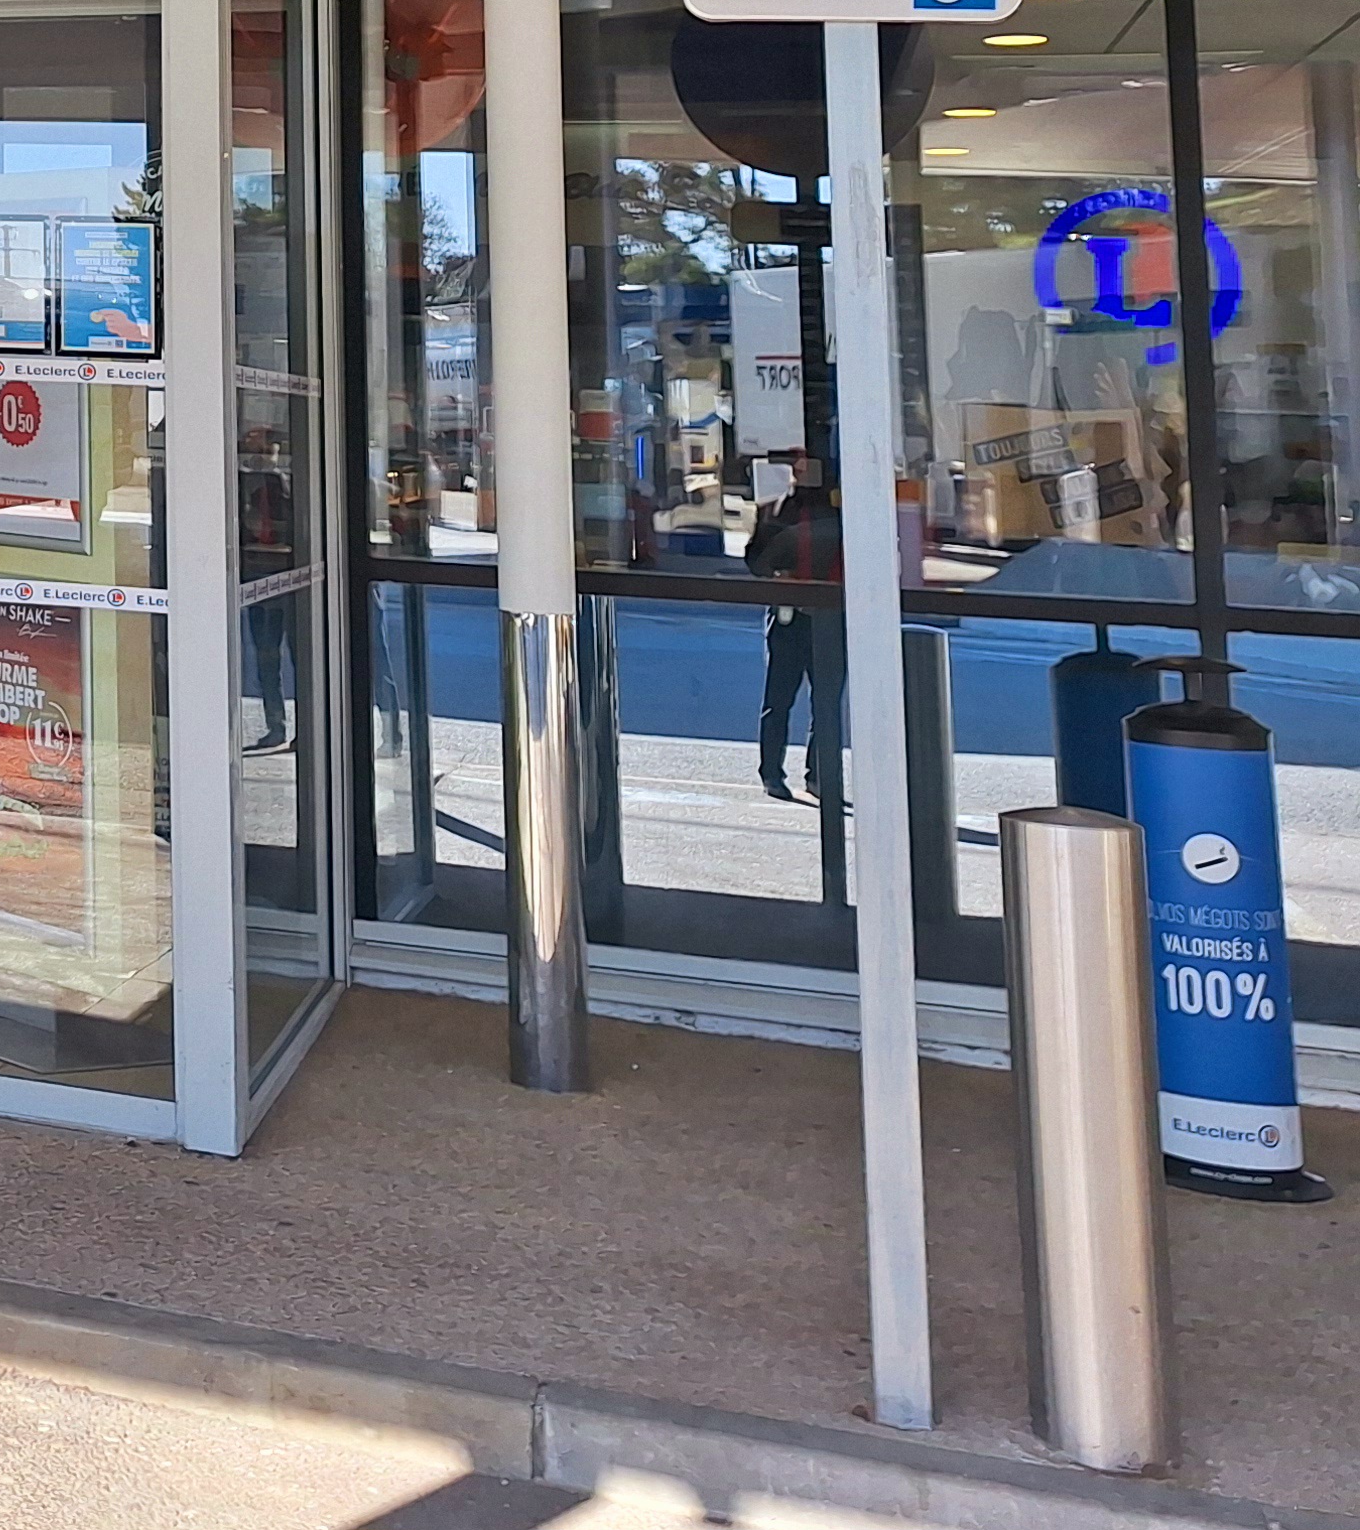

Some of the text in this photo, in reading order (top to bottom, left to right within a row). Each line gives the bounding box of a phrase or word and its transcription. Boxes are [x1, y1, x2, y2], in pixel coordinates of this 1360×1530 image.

[14, 365, 77, 377] E.Leclerc
[43, 588, 106, 603] E.Leclerc
[0, 602, 7, 617] N
[8, 602, 52, 626] SHAKE
[1188, 903, 1251, 931] MÉGOTS
[1161, 932, 1270, 962] VALORISÉS À
[1161, 963, 1276, 1021] 100%
[1172, 1117, 1257, 1143] E.Leclerc
